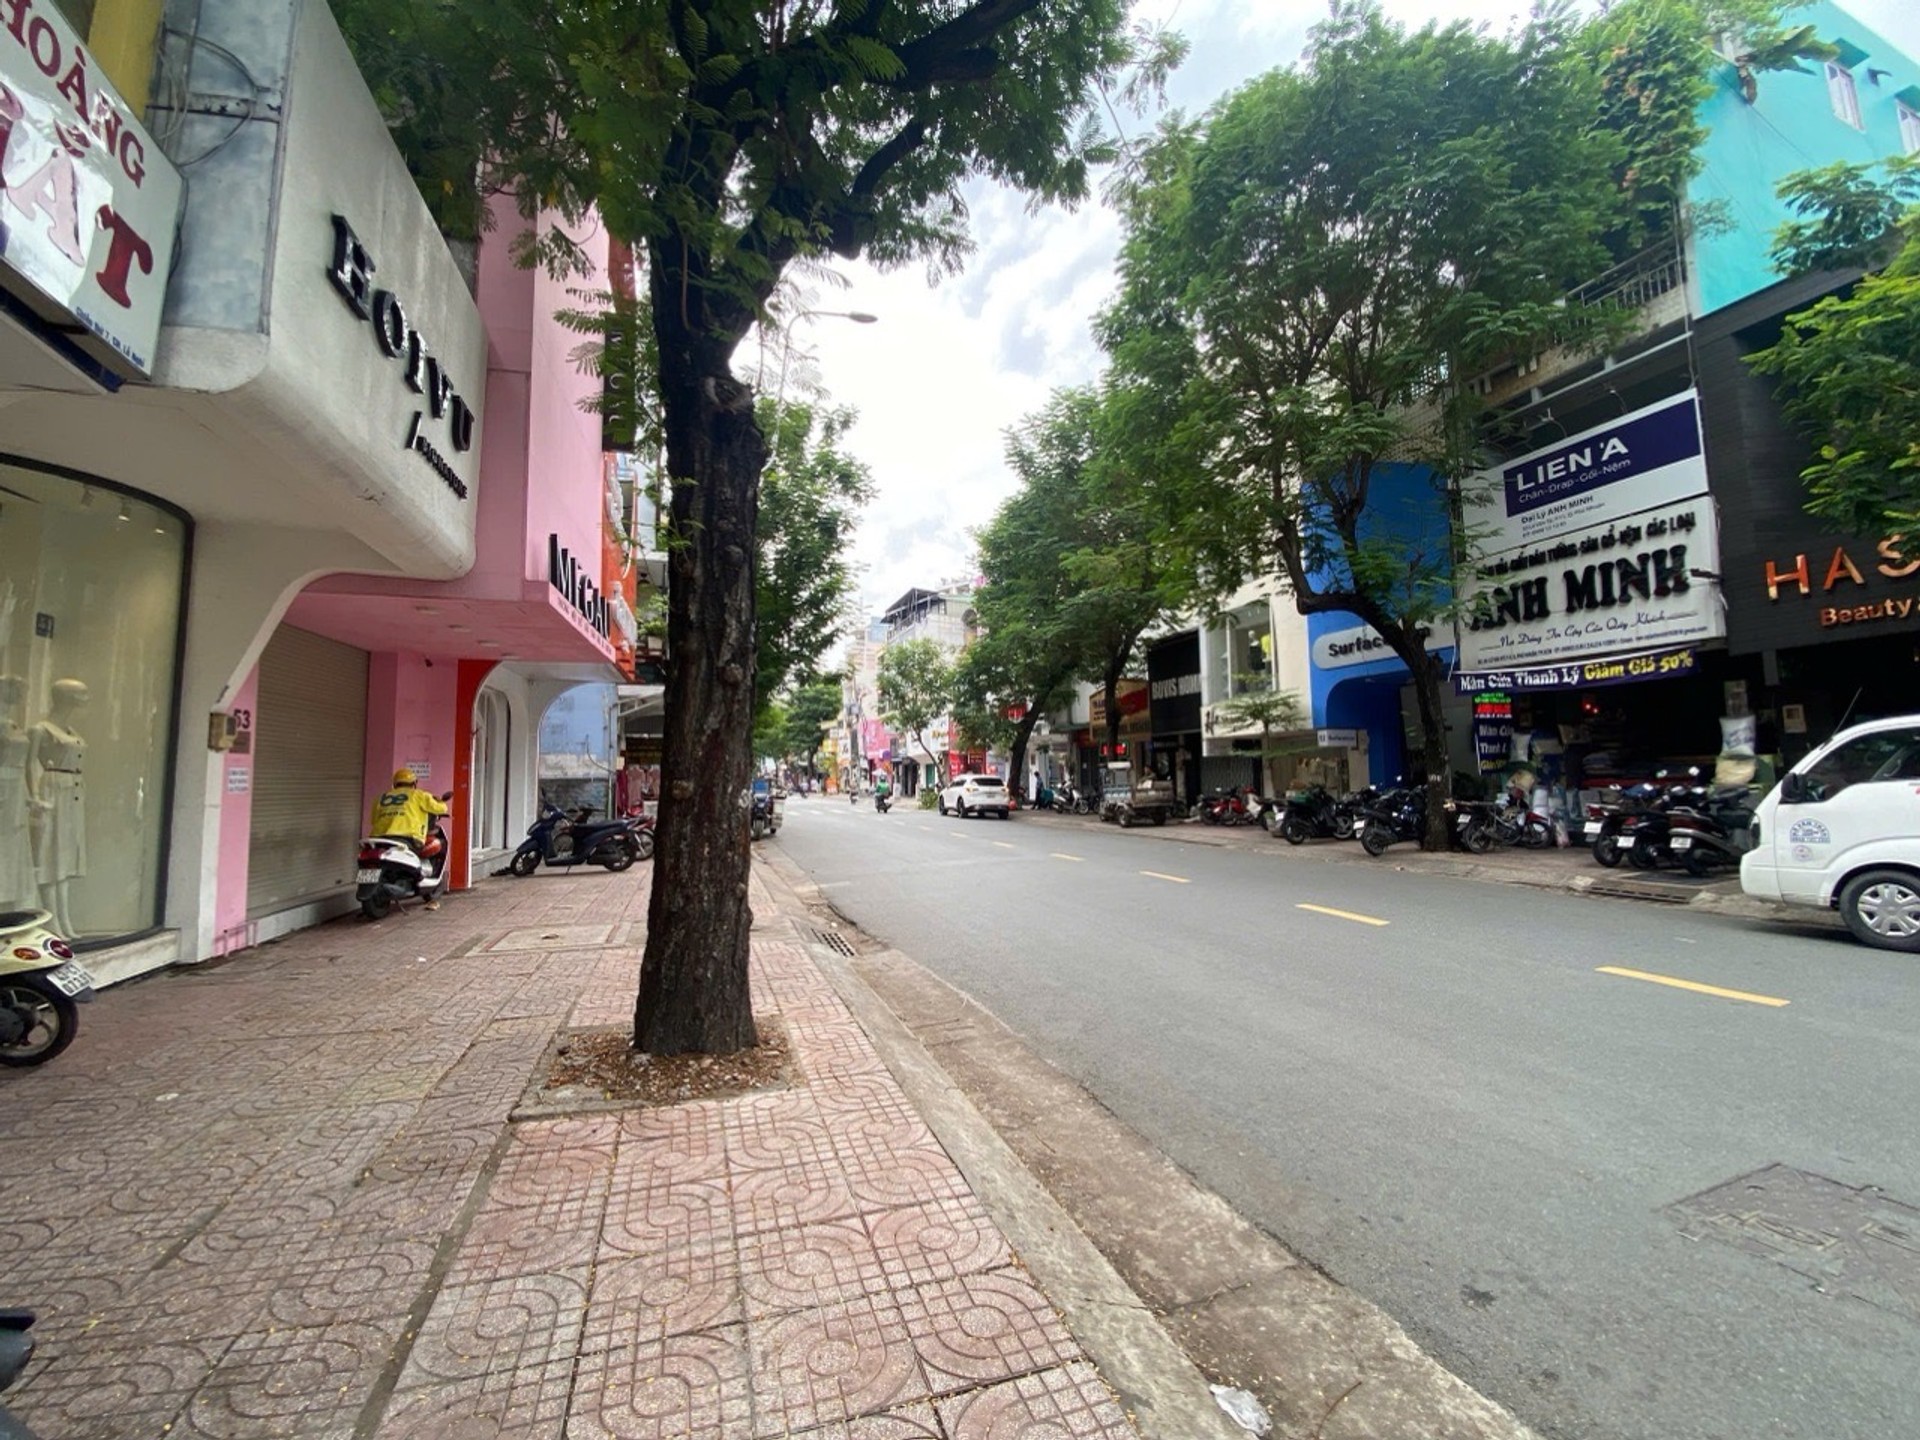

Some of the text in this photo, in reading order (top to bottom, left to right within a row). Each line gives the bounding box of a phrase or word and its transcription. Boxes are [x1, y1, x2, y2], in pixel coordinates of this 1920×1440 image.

[1563, 544, 1691, 613] MINH
[1820, 598, 1912, 627] Beauty
[1328, 635, 1386, 657] Surfac
[1515, 669, 1559, 686] Thanh
[1659, 651, 1694, 672] 50%
